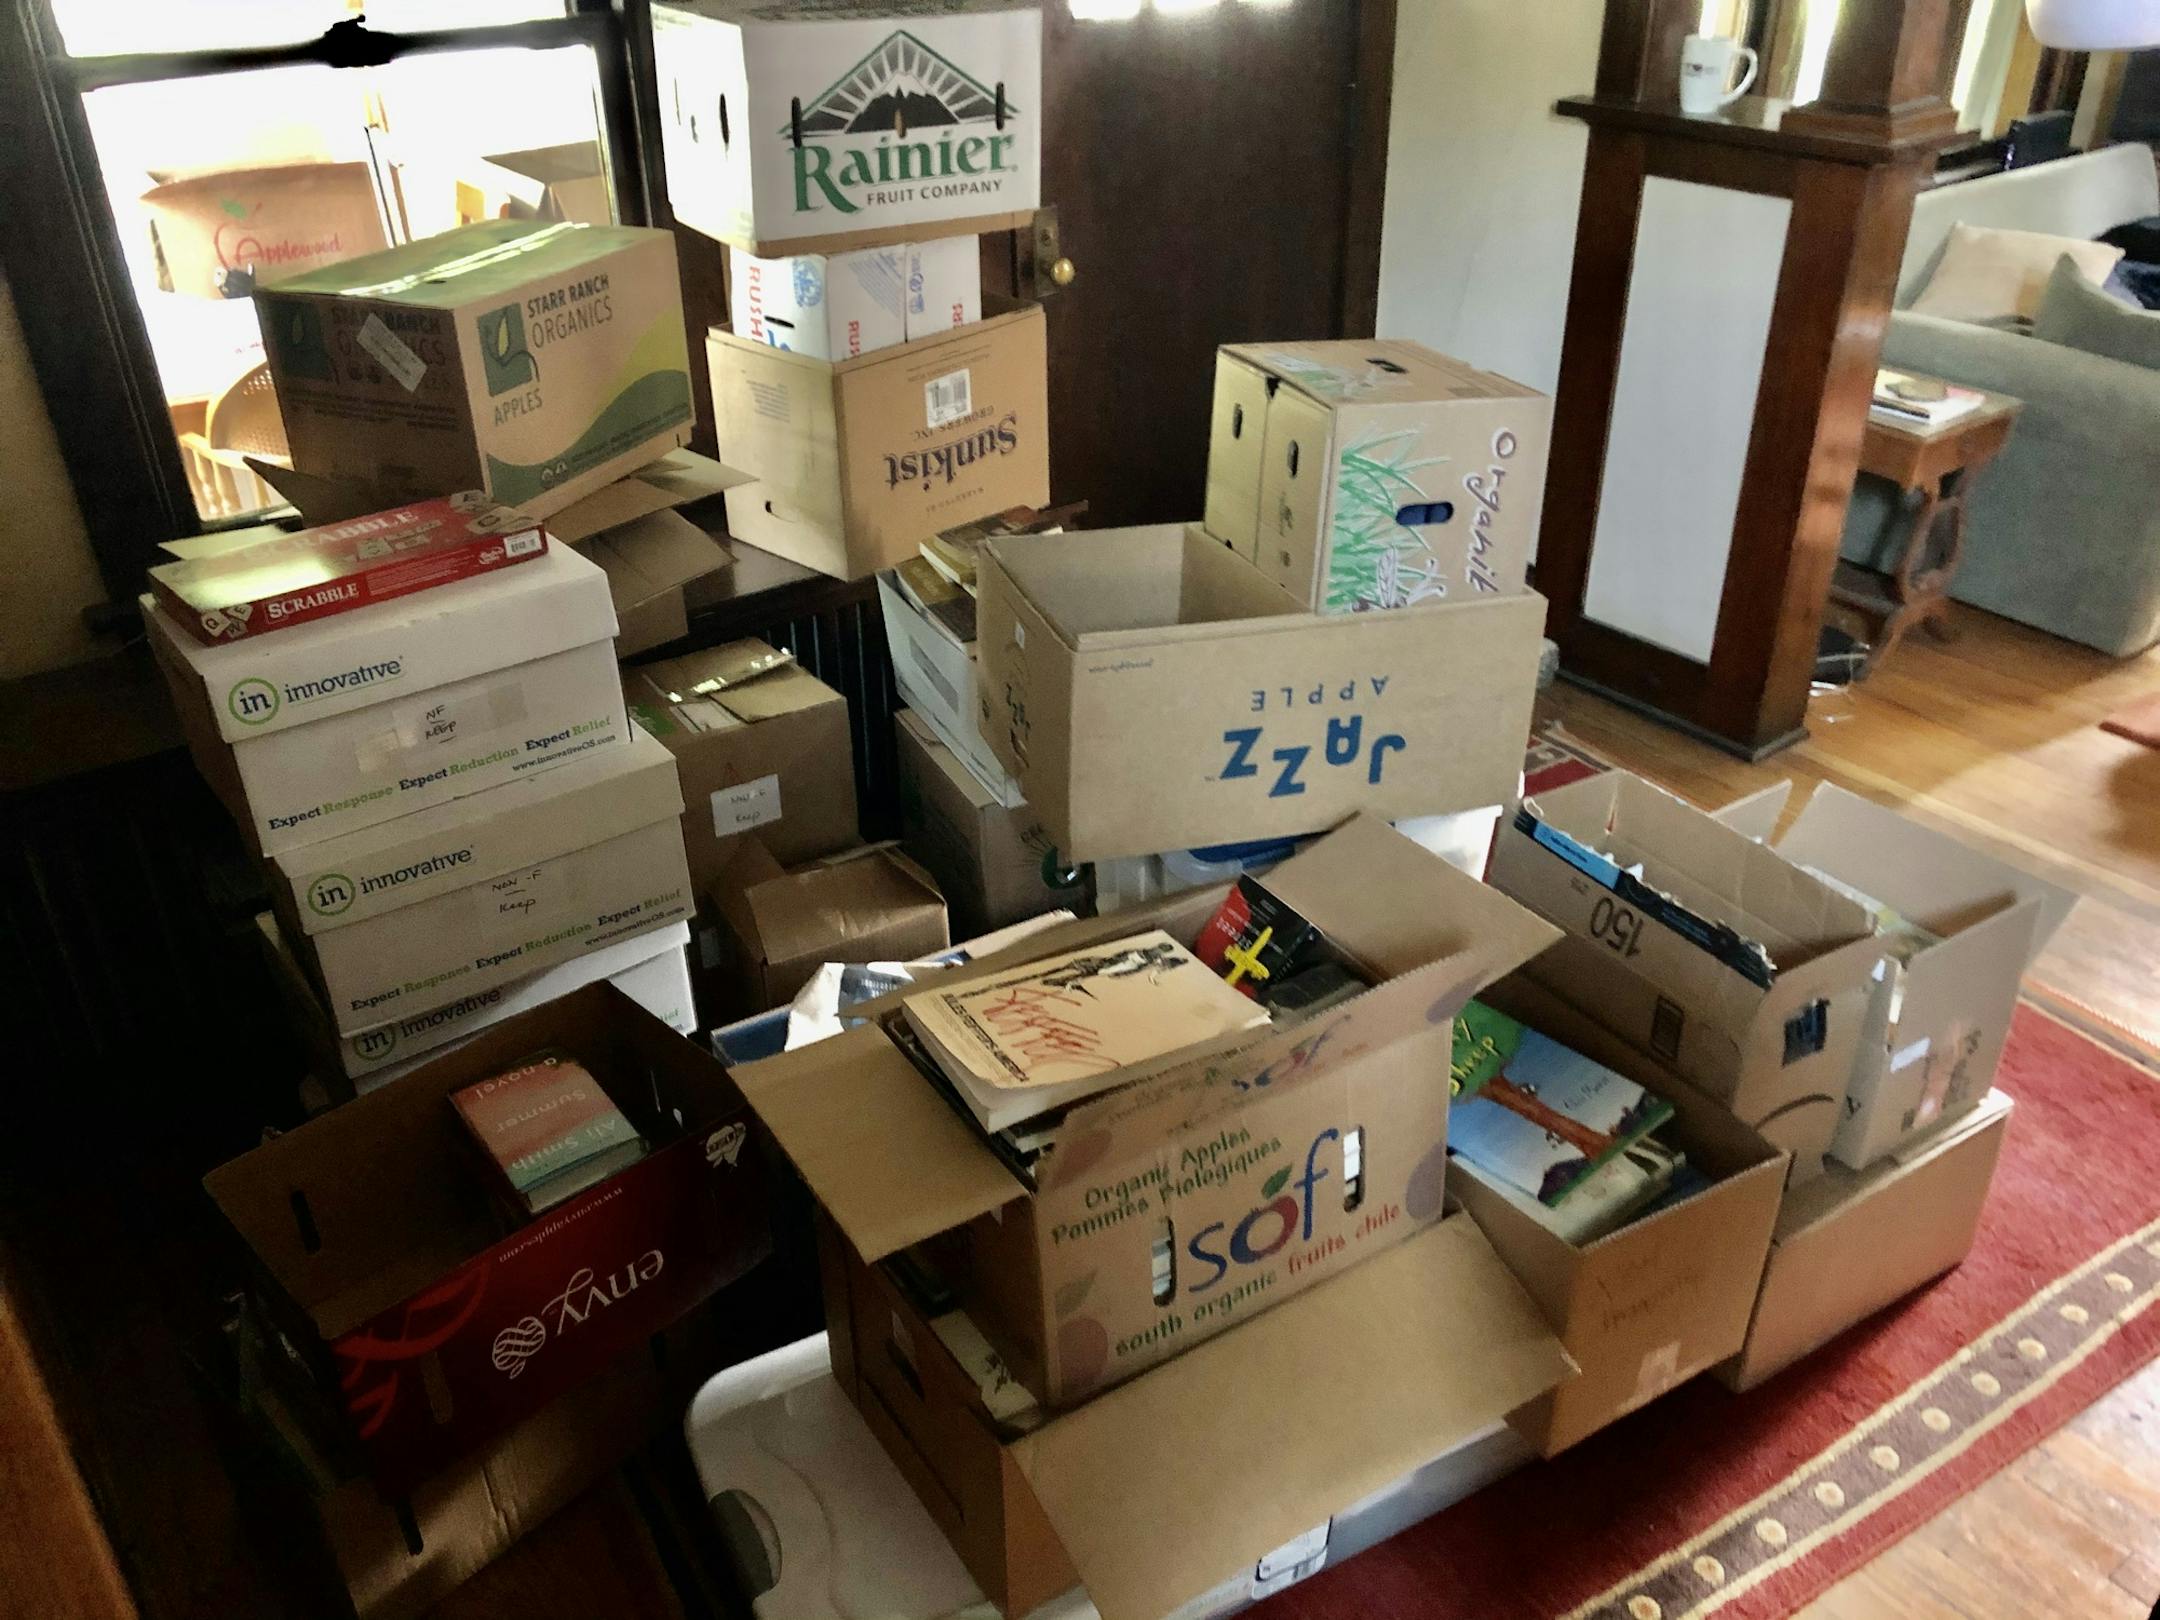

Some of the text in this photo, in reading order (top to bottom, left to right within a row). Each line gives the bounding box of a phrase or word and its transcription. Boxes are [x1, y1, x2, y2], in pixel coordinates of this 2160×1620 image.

[793, 130, 1017, 215] Rainier
[866, 178, 1004, 206] FRUIT COMPANY
[527, 274, 610, 318] STARR RANCH
[532, 296, 613, 348] ORGANICS
[494, 388, 543, 427] APPLES
[883, 411, 1018, 492] Sunkist
[267, 582, 360, 622] SCRABBLE
[240, 657, 402, 715] in innovative
[1252, 676, 1390, 711] APPLE
[268, 804, 321, 831] Expect
[323, 785, 394, 817] Response
[399, 766, 448, 792] Expect
[449, 745, 519, 777] Reduction
[524, 727, 571, 752] Expect
[572, 714, 612, 738] Relief
[1219, 716, 1407, 799] JAZZ
[316, 846, 474, 909] in innovative
[350, 888, 683, 1012] Expect Response Expect Reduction Expect Relief
[1590, 896, 1645, 958] 150
[400, 987, 501, 1038] innovative
[476, 1065, 536, 1100] novel
[495, 1089, 587, 1136] Summer
[511, 1119, 616, 1170] Ali Smith
[1084, 1127, 1251, 1209] Organic Apples
[1051, 1196, 1149, 1247] Pommes
[1188, 1127, 1339, 1293] sof
[541, 1248, 664, 1337] envy
[1115, 1203, 1402, 1357] south organic fruits chile
